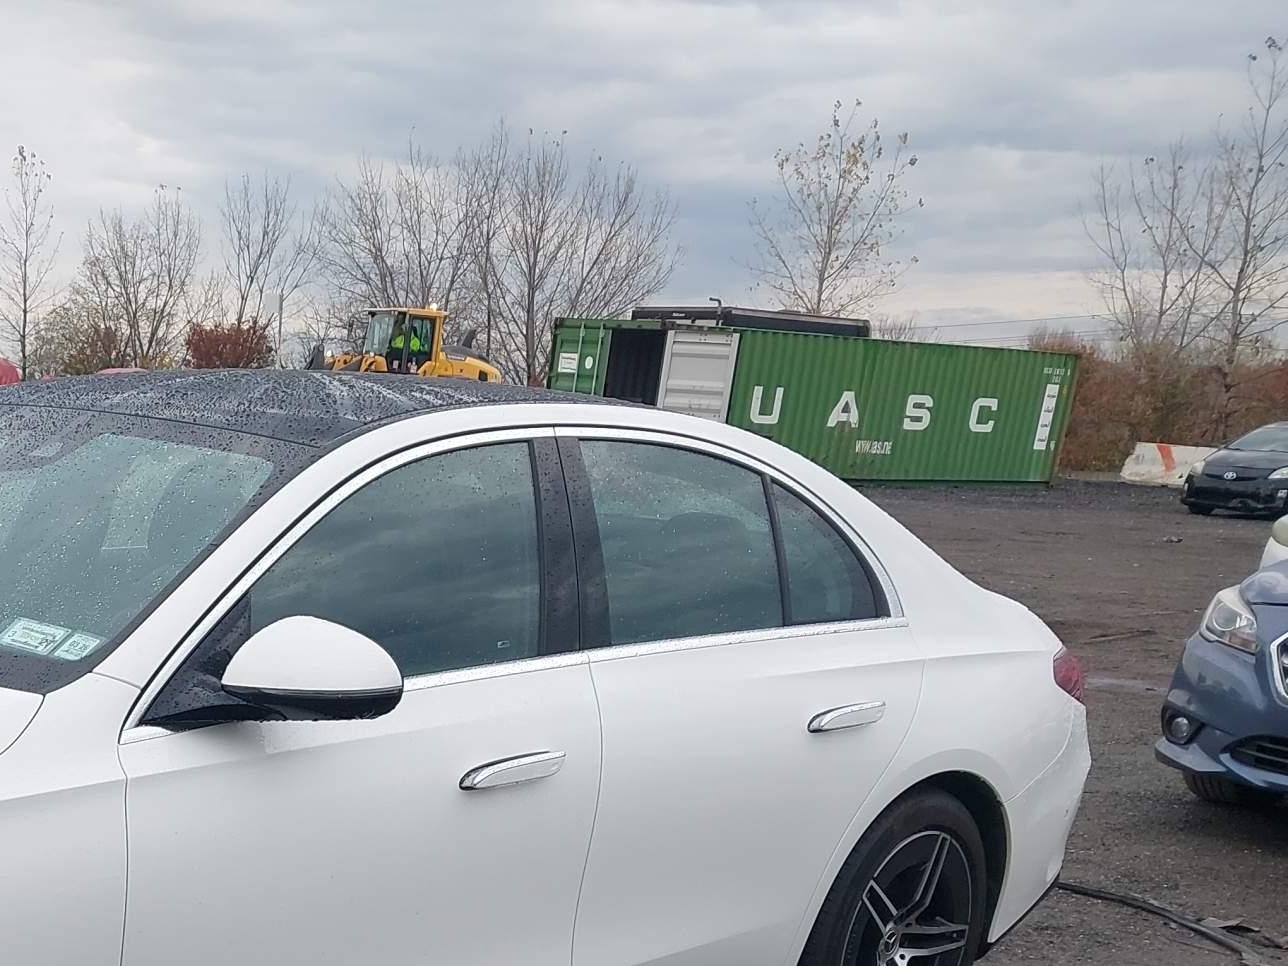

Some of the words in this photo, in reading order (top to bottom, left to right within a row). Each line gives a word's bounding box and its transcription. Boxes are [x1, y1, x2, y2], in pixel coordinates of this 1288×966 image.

[750, 385, 785, 424] U
[826, 391, 859, 428] A
[903, 394, 934, 430] S
[968, 398, 999, 432] C
